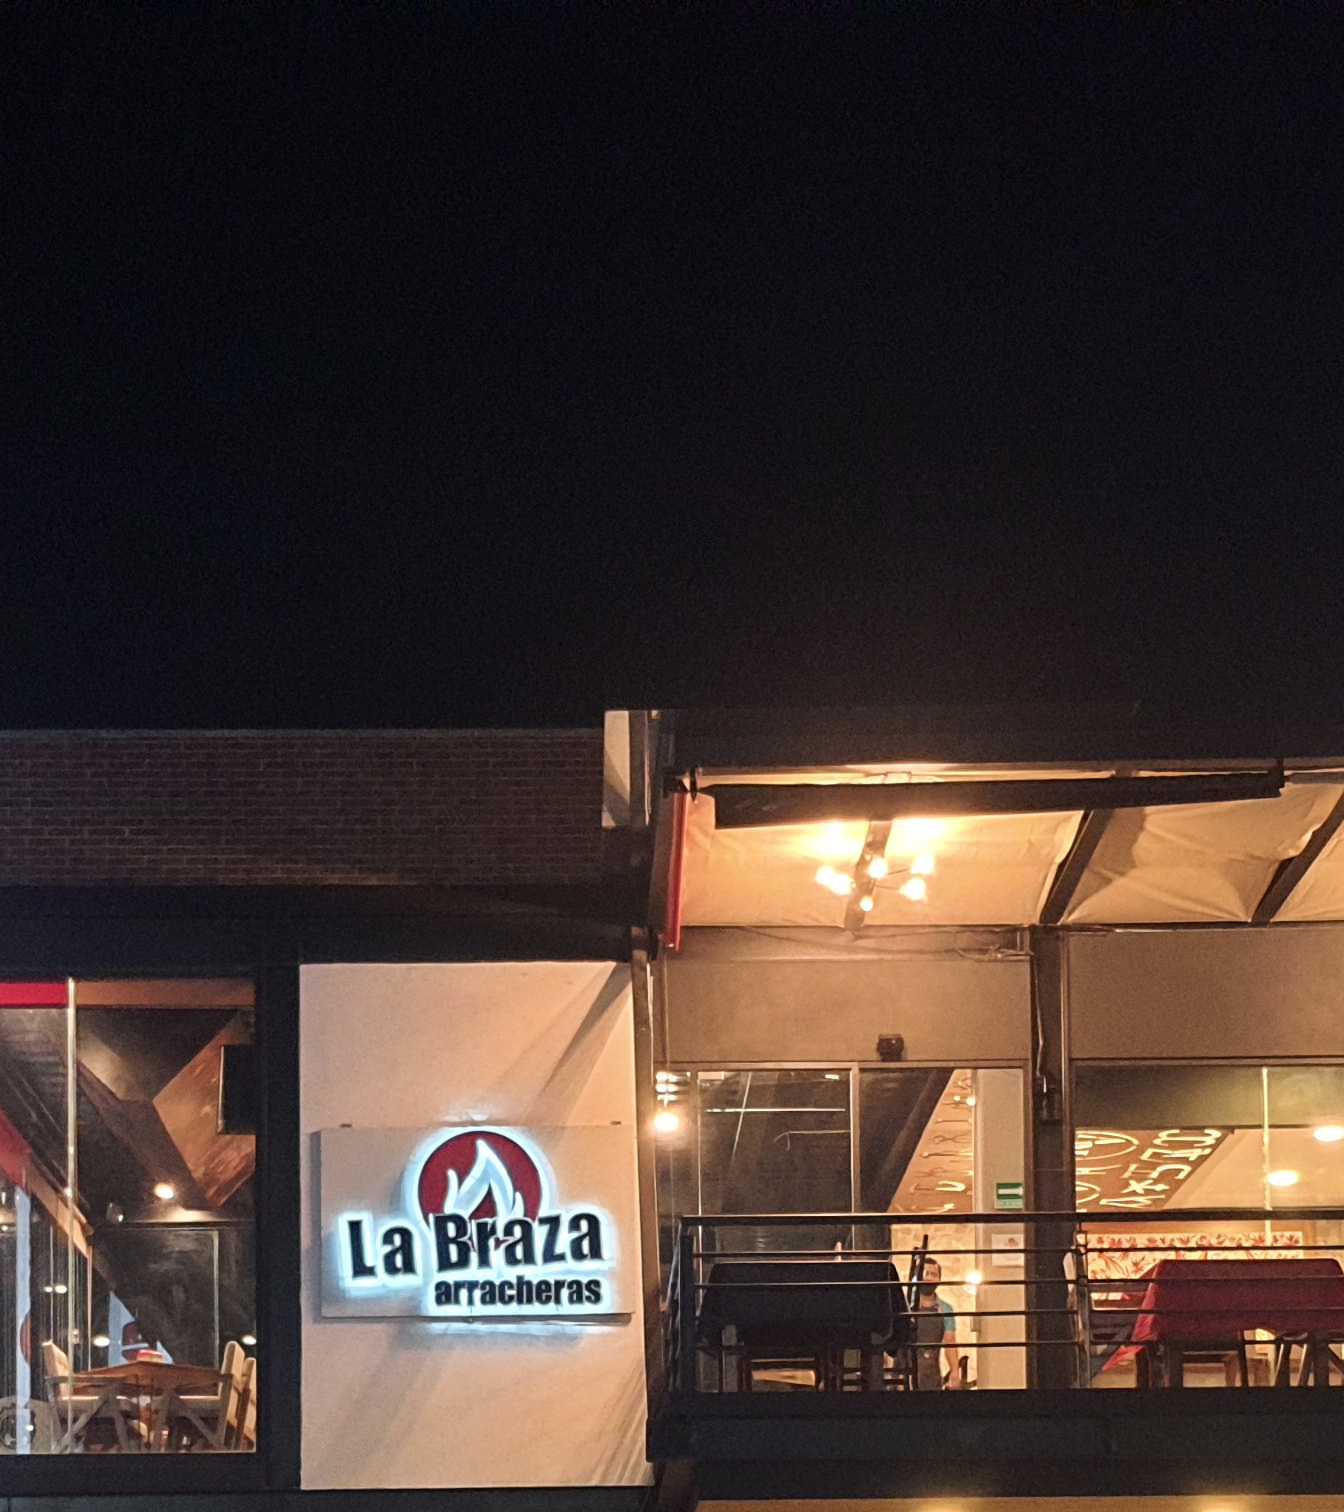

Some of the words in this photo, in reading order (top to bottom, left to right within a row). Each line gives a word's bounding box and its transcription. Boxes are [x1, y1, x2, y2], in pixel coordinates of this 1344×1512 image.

[347, 1219, 418, 1279] La
[433, 1211, 606, 1273] Braza
[434, 1275, 603, 1306] arracheras
